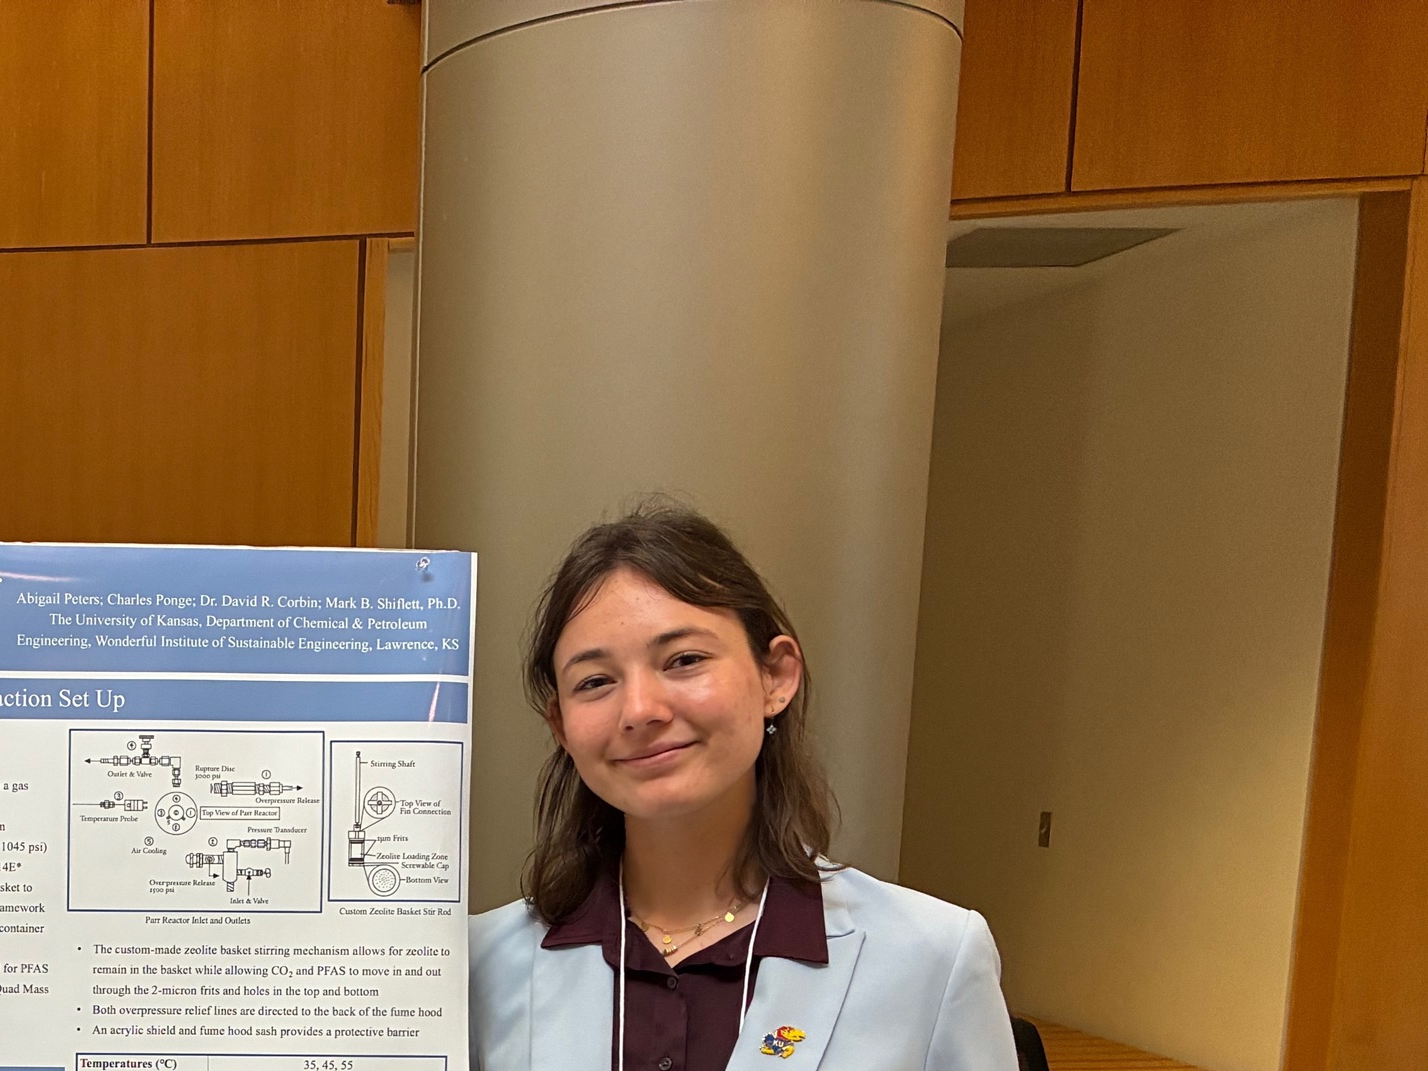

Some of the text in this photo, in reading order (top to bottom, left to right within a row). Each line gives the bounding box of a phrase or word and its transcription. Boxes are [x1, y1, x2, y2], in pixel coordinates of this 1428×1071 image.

[15, 591, 460, 610] Abigail Peters; Charles Ponge; Dr. David R. Corbin; Mark B. Shiflett, Ph.D.
[48, 612, 427, 630] The University of Kansas, Department of Chemical & Petroleum
[16, 633, 459, 653] Engineering, Wonderful Institute of Sustainable Engineering, Lawrence, KS
[58, 688, 89, 707] Set
[94, 689, 125, 712] Up
[144, 915, 251, 924] Parr Reactor Inlet and Outlets
[79, 1057, 152, 1071] Temperatures
[303, 1059, 353, 1071] 35, 45, 55
